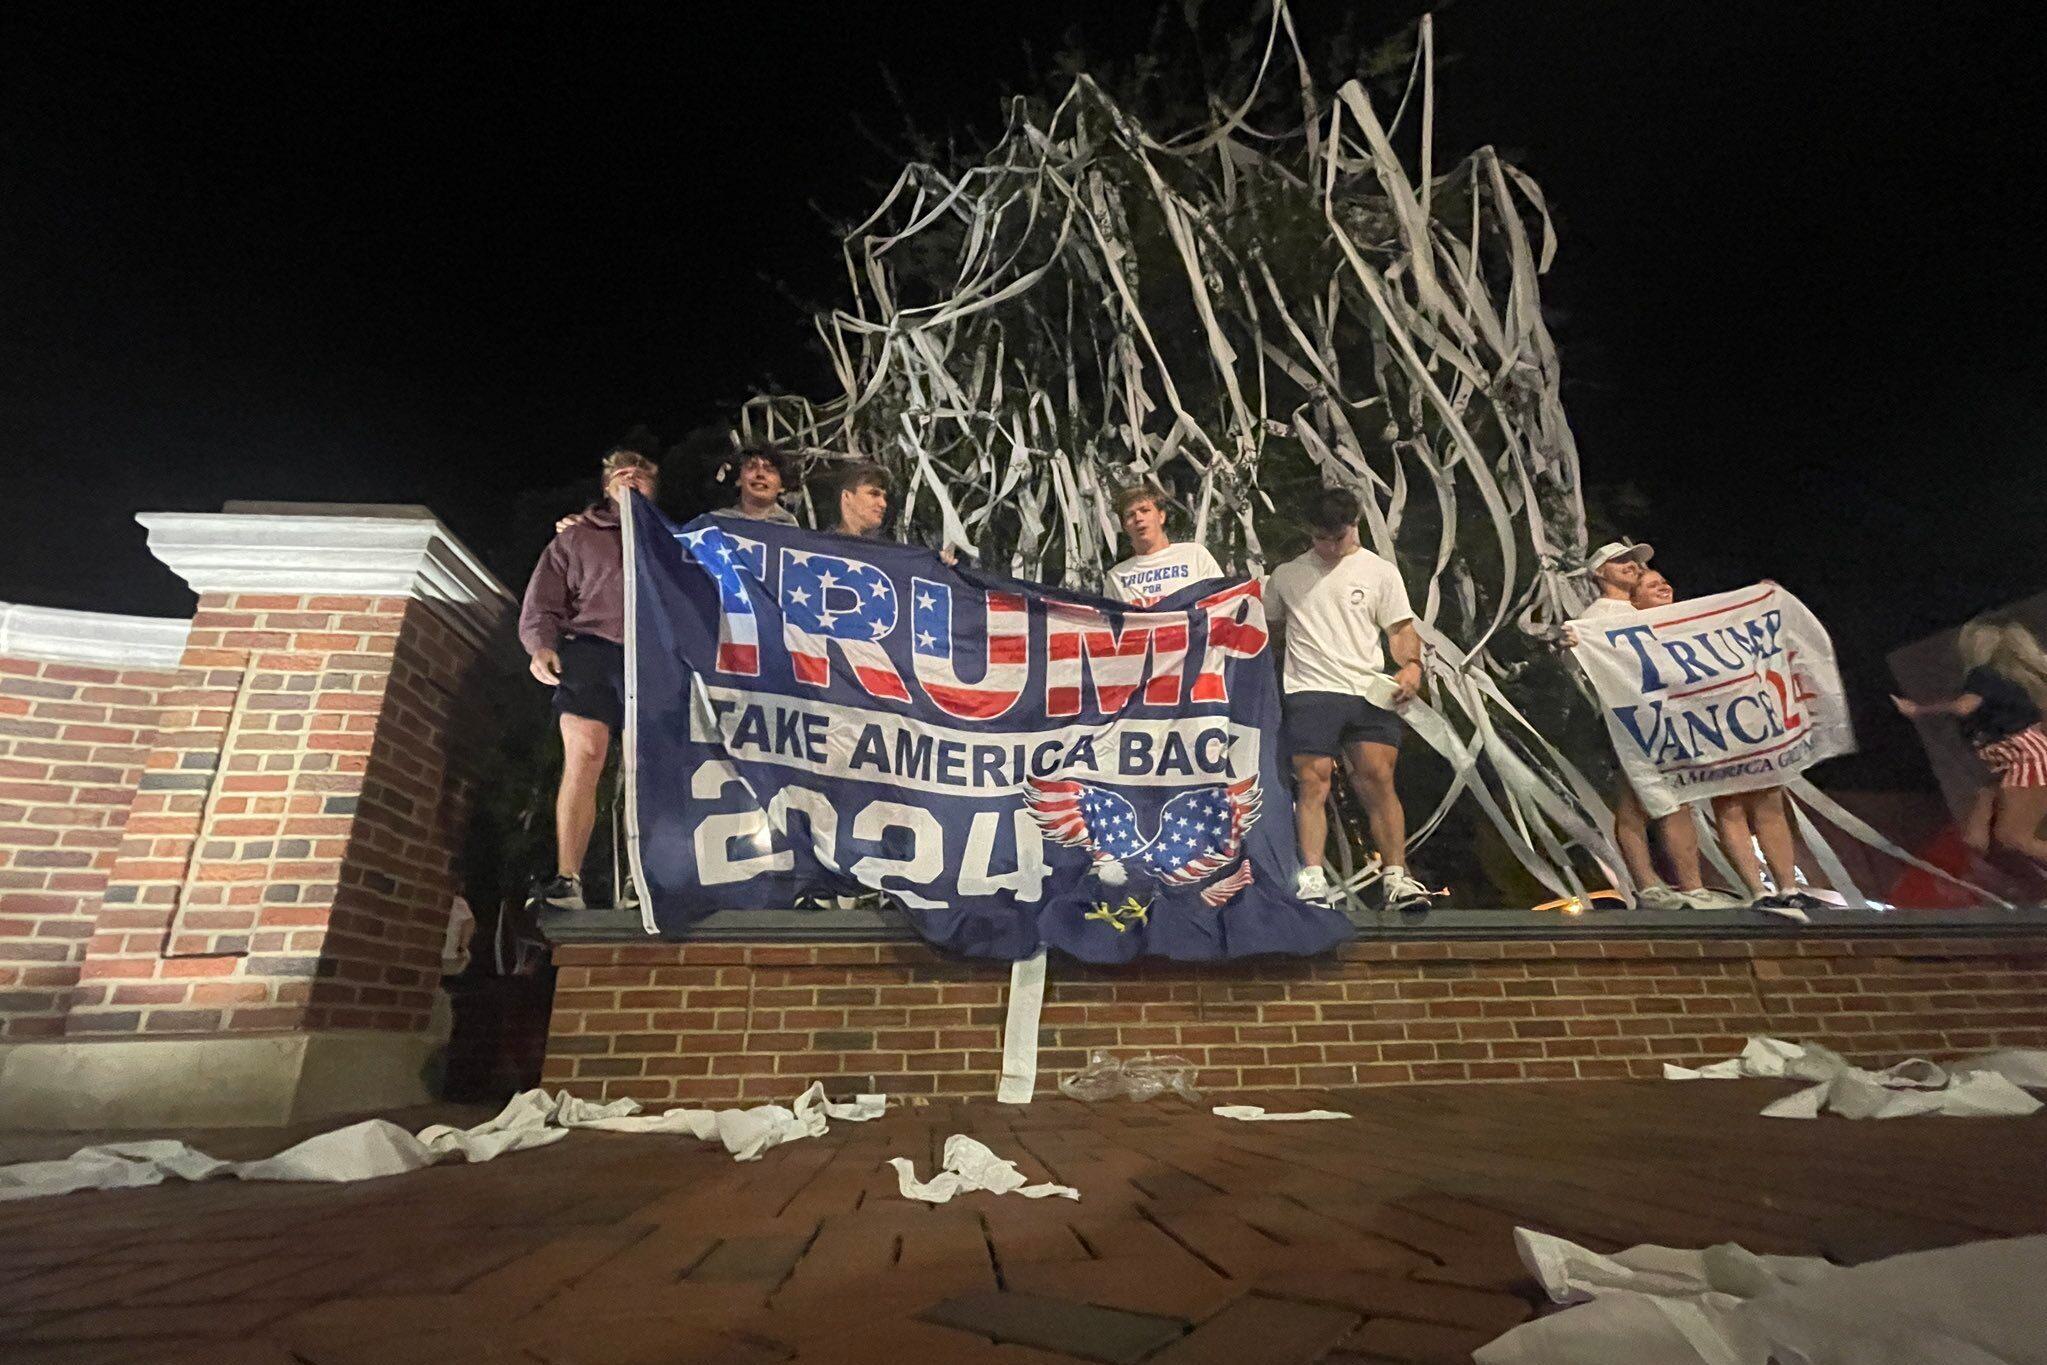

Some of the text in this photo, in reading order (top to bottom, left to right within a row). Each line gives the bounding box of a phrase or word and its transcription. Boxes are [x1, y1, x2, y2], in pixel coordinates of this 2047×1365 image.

[1120, 565, 1189, 588] TRUCKERS
[1143, 584, 1162, 593] FOR
[673, 525, 1269, 720] TRUMP
[1605, 609, 1783, 694] TRUMP
[848, 723, 1099, 788] AMERICA
[1612, 691, 1785, 766] VANCE
[691, 759, 1054, 910] 2024
